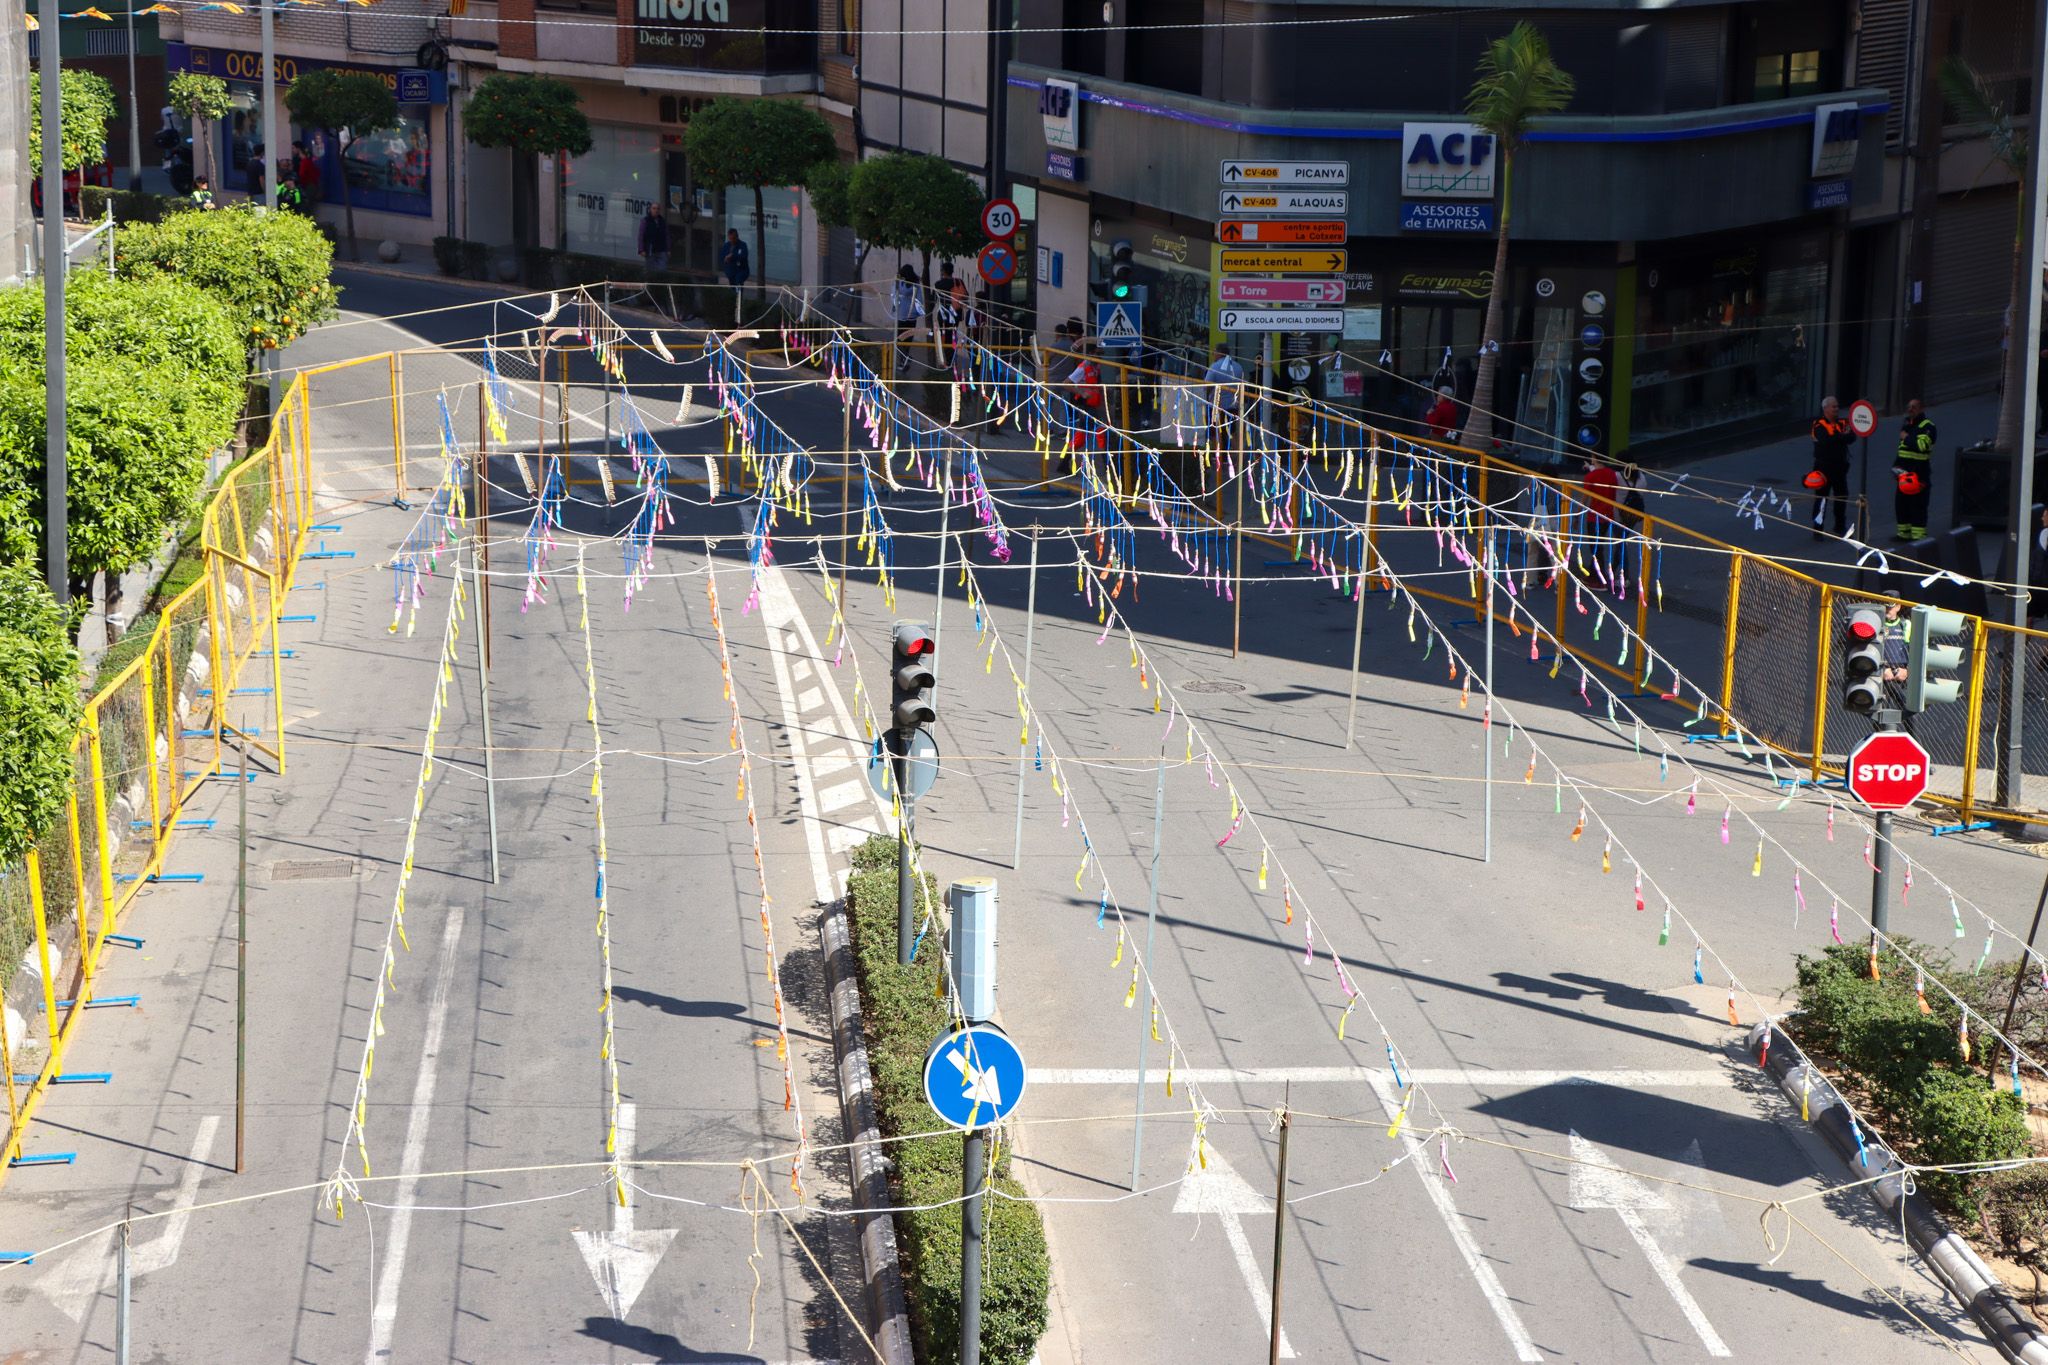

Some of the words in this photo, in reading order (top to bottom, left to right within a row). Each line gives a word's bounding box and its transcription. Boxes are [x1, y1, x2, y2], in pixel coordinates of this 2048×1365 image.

[639, 30, 674, 47] Desde
[679, 32, 705, 49] 1929
[404, 88, 428, 97] OCASO
[1407, 133, 1492, 166] ACF
[1244, 168, 1278, 177] CV-406
[1295, 168, 1345, 178] PICANYA
[577, 193, 605, 211] mora
[1243, 198, 1277, 206] CV-403
[1412, 205, 1480, 217] ASESORES
[750, 212, 778, 229] mra
[991, 212, 1012, 228] 30
[1405, 219, 1422, 228] de
[1426, 219, 1487, 230] EMPRESA
[1312, 224, 1343, 232] sportiu
[1223, 257, 1261, 266] mercat
[1264, 257, 1303, 266] central
[1222, 285, 1235, 295] La
[1240, 285, 1268, 296] Torre
[1346, 281, 1373, 291] LLAVE
[1858, 764, 1921, 782] STOP
